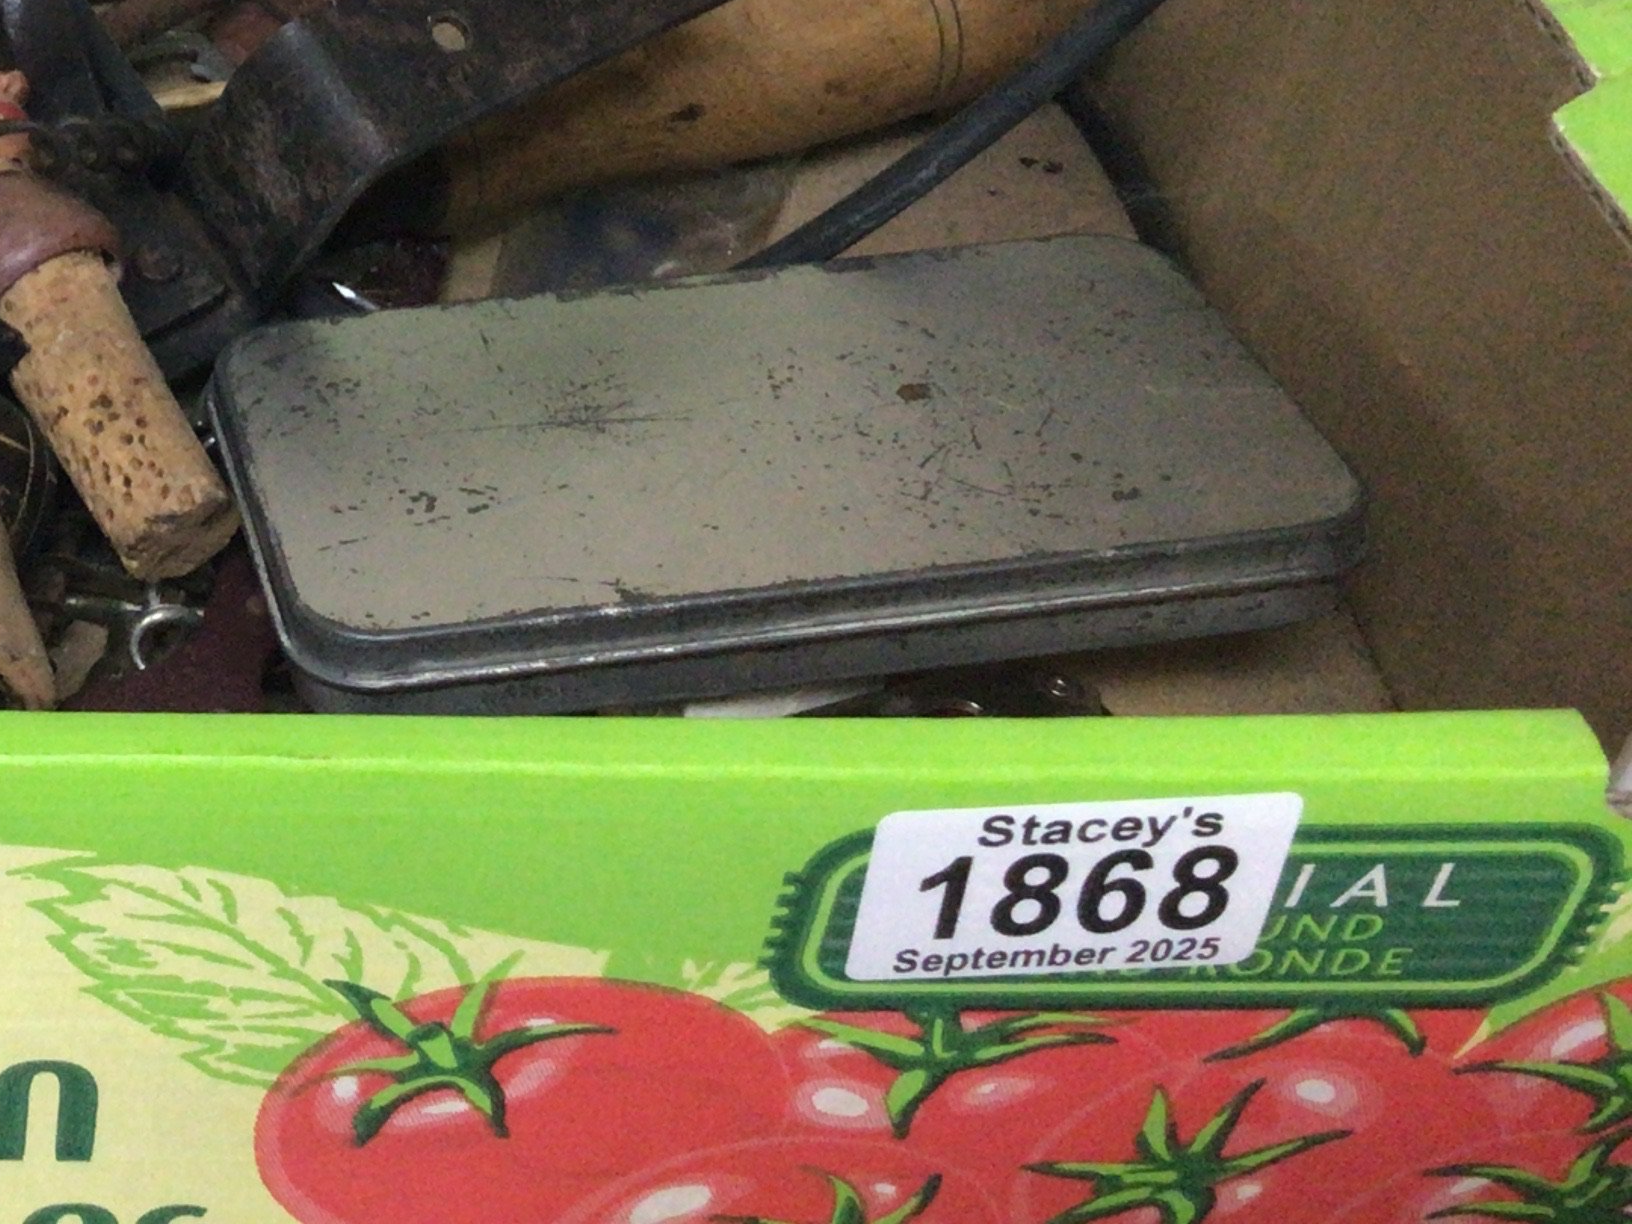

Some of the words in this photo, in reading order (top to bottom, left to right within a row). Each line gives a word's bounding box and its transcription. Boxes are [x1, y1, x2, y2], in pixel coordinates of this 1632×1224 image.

[976, 807, 1225, 848] Stacey's
[918, 844, 1240, 941] 1868
[1284, 862, 1462, 908] IAL
[892, 942, 1117, 976] September
[1124, 936, 1222, 963] 2025
